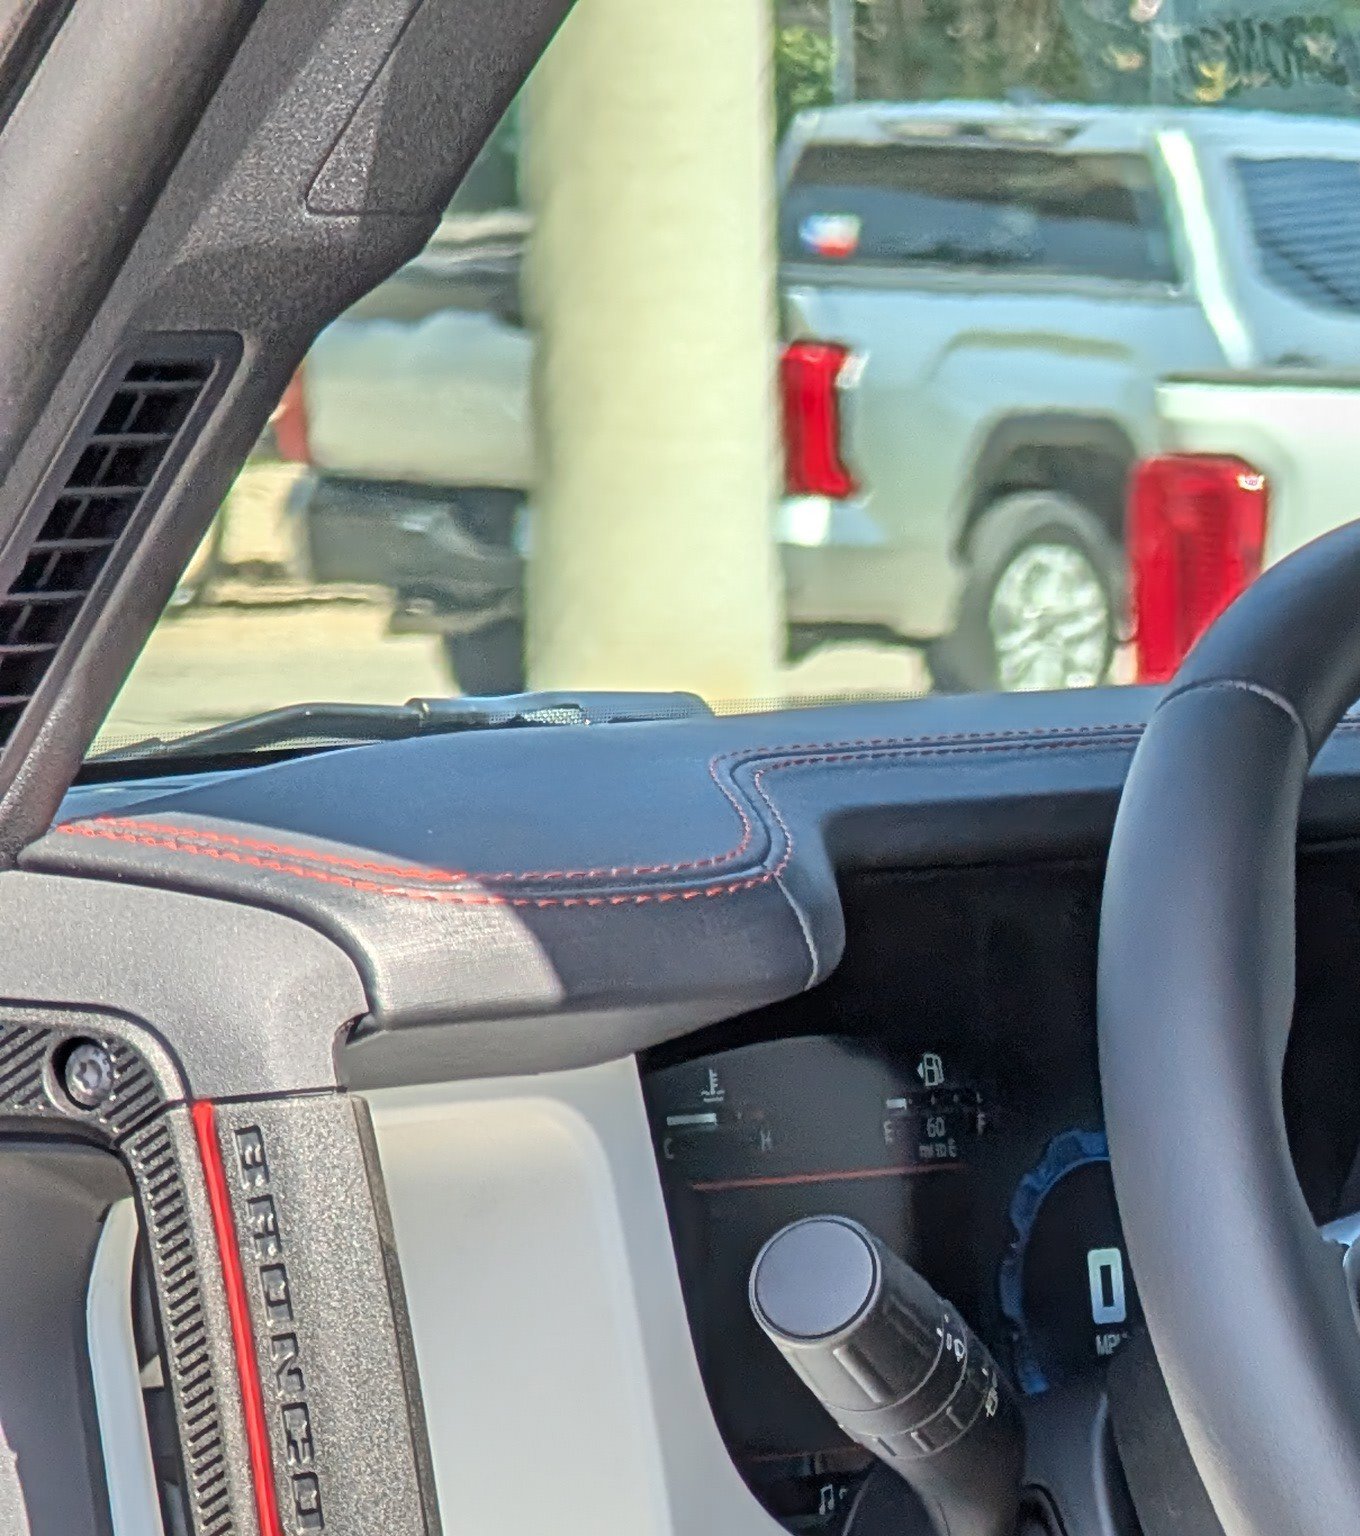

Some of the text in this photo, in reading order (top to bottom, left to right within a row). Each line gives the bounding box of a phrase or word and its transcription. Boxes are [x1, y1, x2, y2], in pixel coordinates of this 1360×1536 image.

[926, 1116, 946, 1138] 60
[1086, 1247, 1128, 1325] 0
[233, 1125, 325, 1531] BRONCO
[1095, 1332, 1128, 1356] MP
